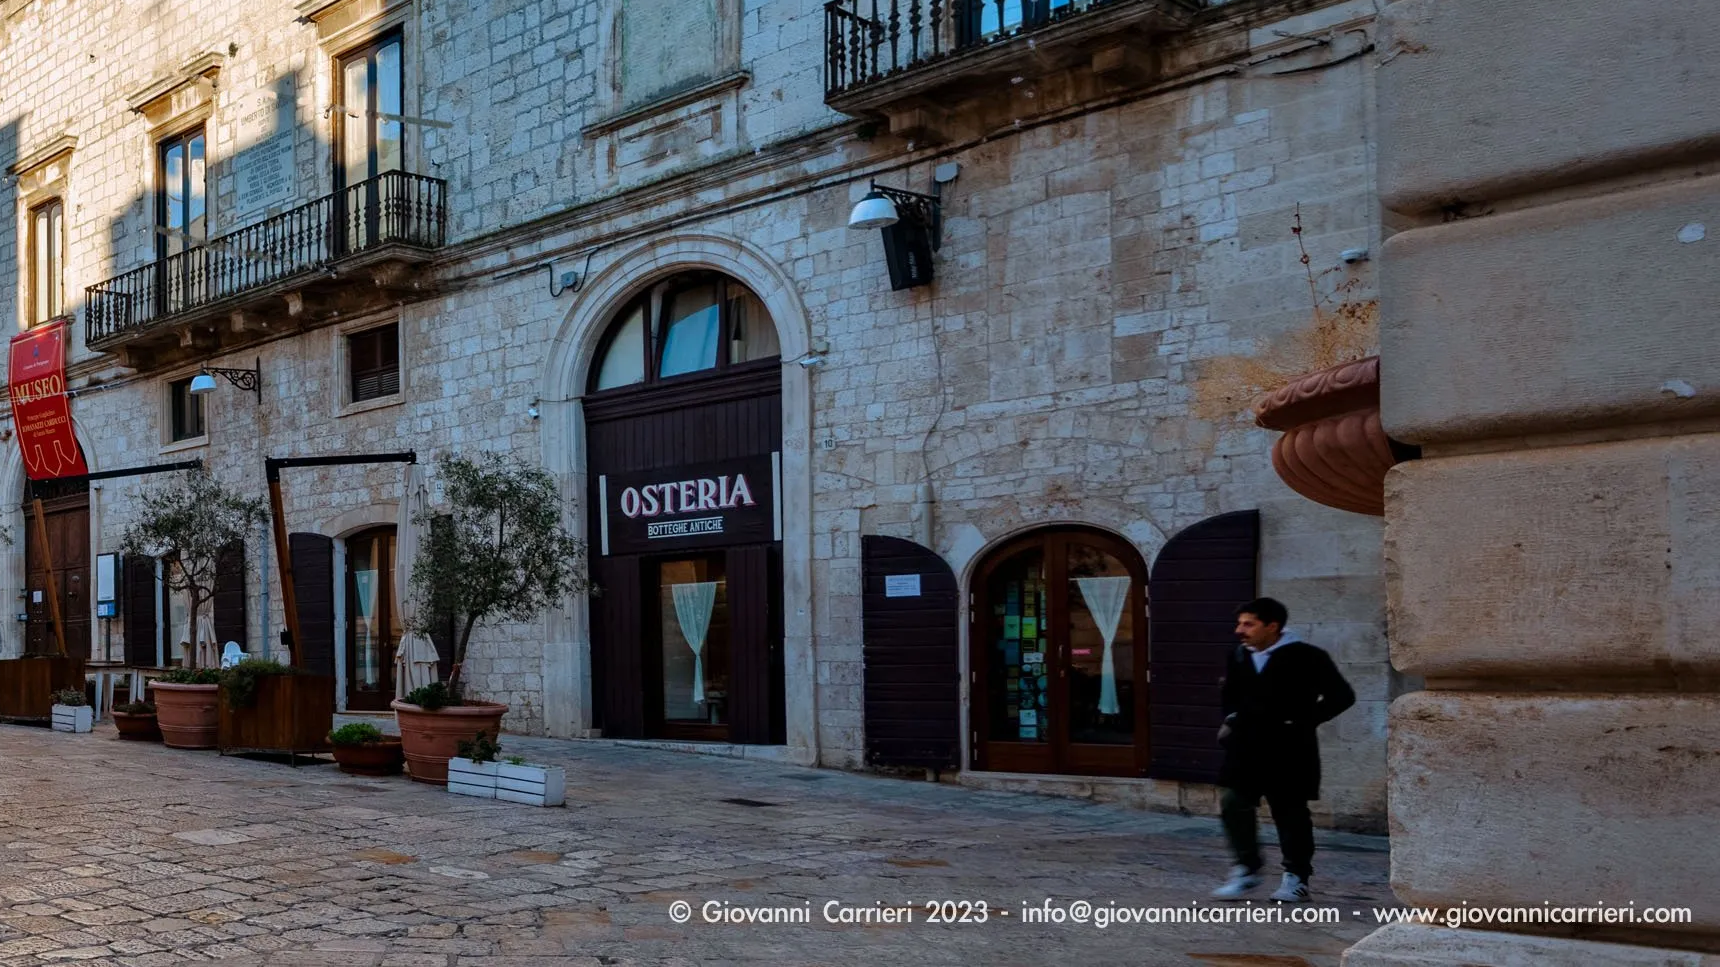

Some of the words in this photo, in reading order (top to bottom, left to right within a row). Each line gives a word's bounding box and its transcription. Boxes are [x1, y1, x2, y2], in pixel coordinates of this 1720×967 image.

[15, 375, 61, 405] MUSEO
[824, 439, 833, 448] 10
[621, 473, 756, 518] OSTERIA
[648, 522, 688, 536] BOTTEGHE
[690, 519, 723, 532] ANTICHE
